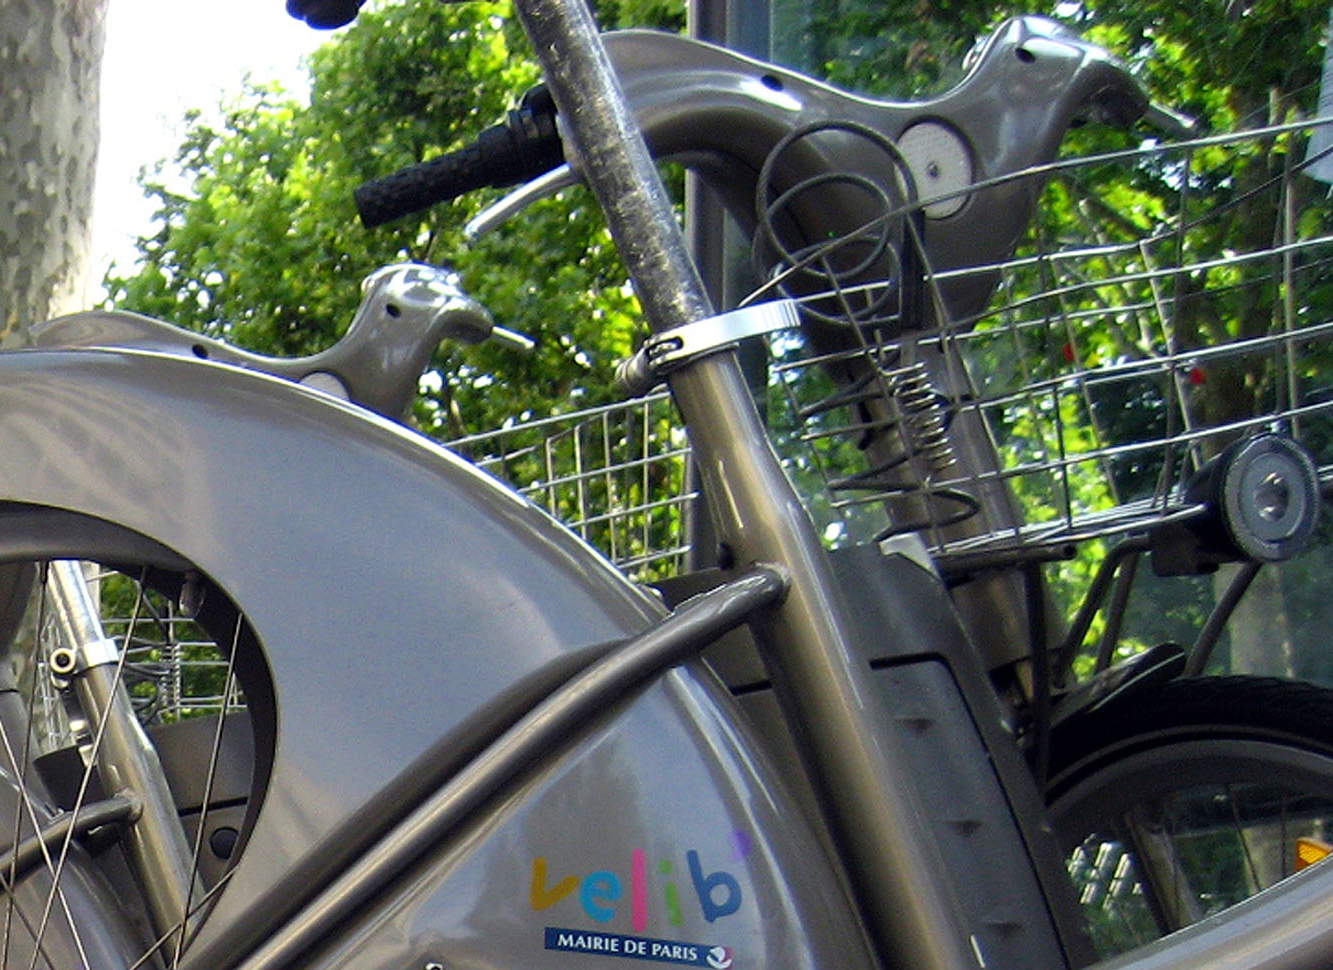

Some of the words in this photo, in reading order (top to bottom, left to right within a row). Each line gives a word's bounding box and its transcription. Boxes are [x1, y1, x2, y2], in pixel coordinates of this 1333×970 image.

[557, 933, 619, 952] MAIRIE
[624, 939, 647, 955] DE
[651, 943, 698, 961] PARIS
